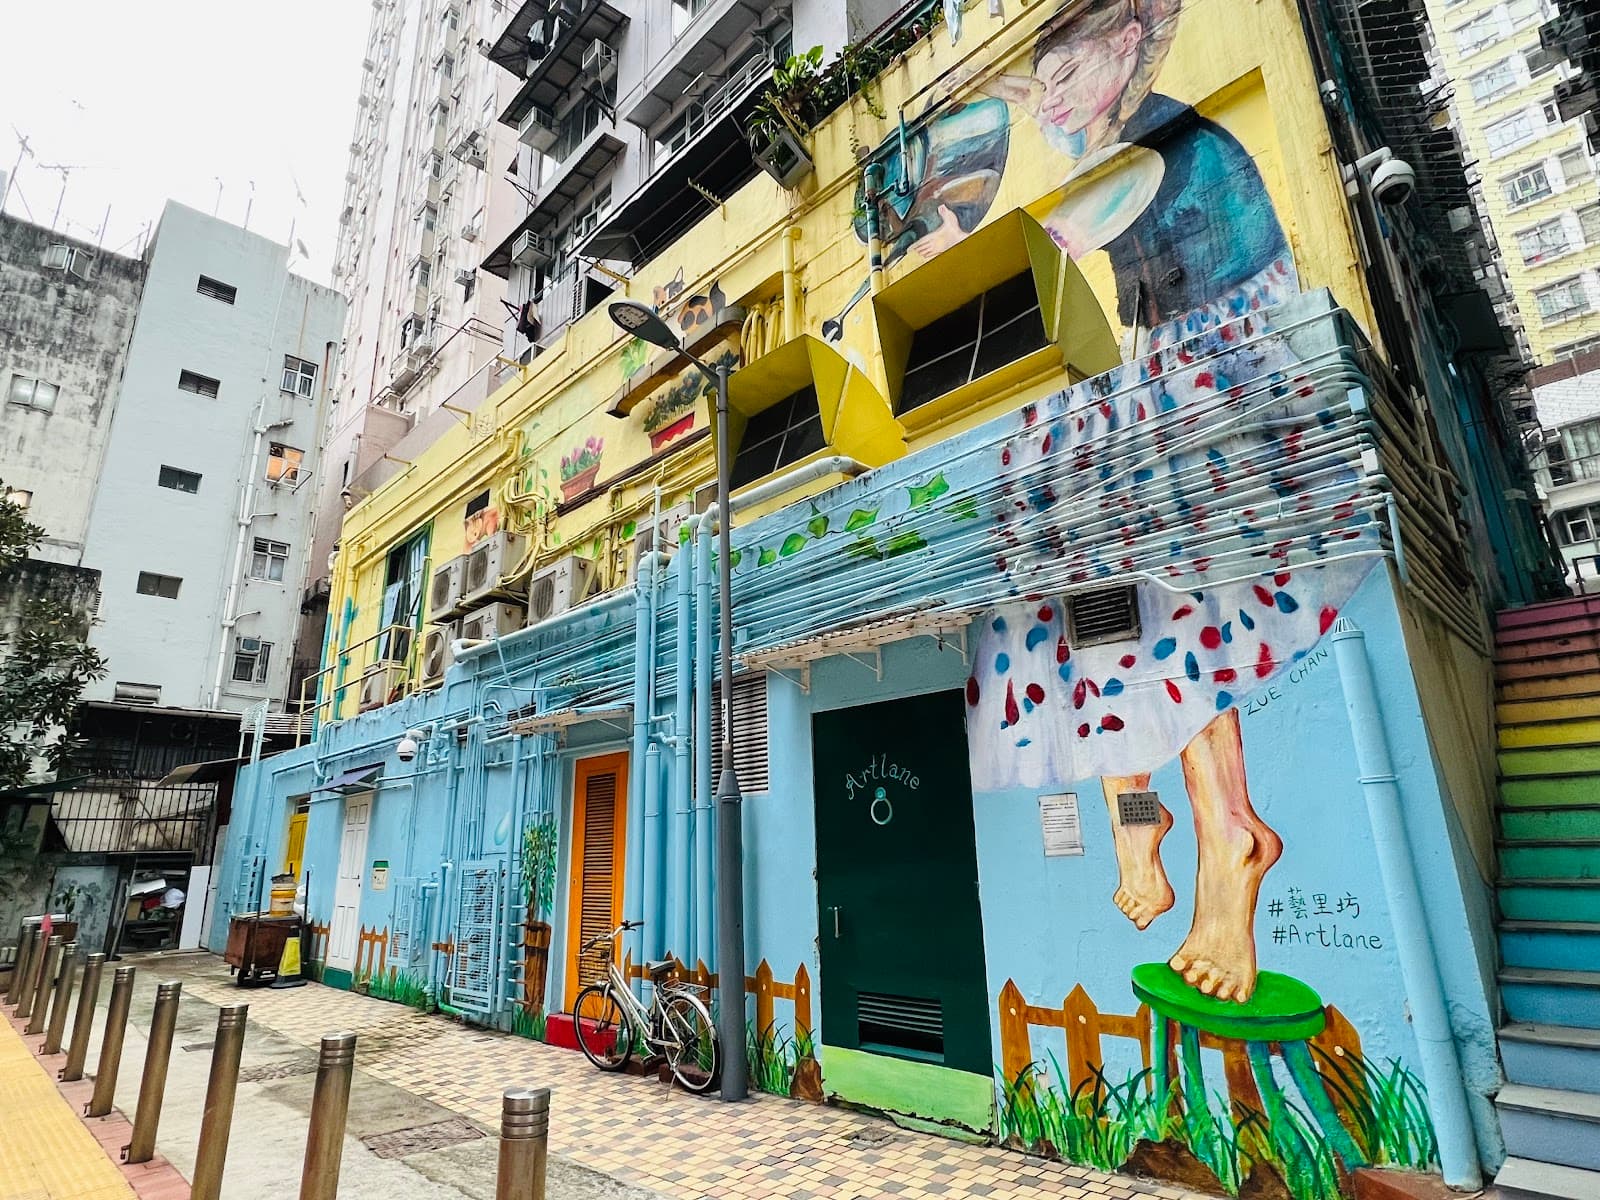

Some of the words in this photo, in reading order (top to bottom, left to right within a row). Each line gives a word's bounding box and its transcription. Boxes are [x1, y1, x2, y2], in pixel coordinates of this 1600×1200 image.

[1243, 686, 1283, 717] ZUE
[1289, 648, 1329, 684] CHAN
[846, 752, 920, 801] Artlane
[1272, 923, 1383, 949] #Artlane
